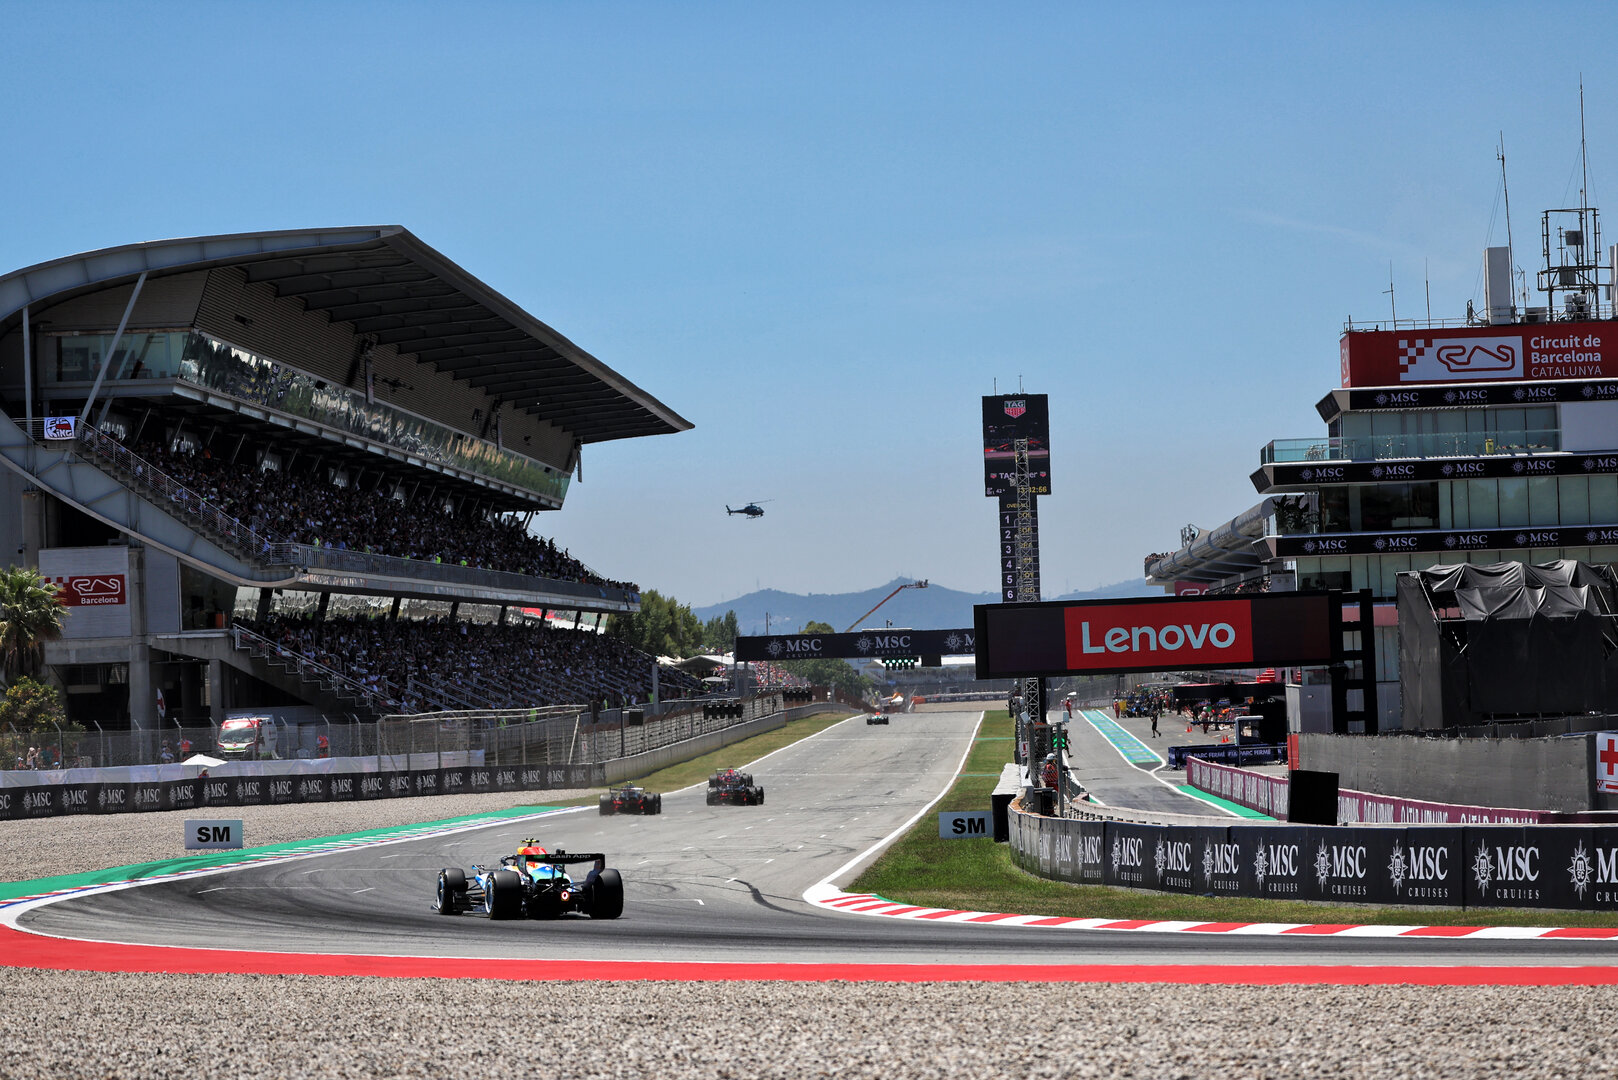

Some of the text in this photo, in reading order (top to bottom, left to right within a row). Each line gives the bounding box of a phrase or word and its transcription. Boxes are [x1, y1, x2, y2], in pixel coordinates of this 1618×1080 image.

[1530, 334, 1601, 349] Circuit de
[1531, 350, 1602, 364] Barcelona
[1531, 366, 1602, 377] CATALUNYA
[1459, 390, 1488, 400] MSC
[1528, 387, 1557, 397] MSC
[1597, 385, 1618, 395] MS
[1391, 392, 1419, 402] MSC
[1386, 465, 1415, 475] MSC
[1456, 463, 1485, 472] MSC
[1527, 460, 1556, 470] MSC
[1315, 468, 1344, 477] MSC
[1005, 515, 1010, 524] 1
[1005, 530, 1011, 539] 2
[1459, 535, 1488, 544] MSC
[1529, 532, 1559, 542] MSC
[1318, 540, 1347, 550] MSC
[1389, 537, 1418, 547] MSC
[1005, 545, 1011, 554] 3
[1006, 560, 1012, 568] 4
[1006, 575, 1013, 583] 5
[80, 596, 119, 604] Barcelona
[1007, 590, 1014, 599] 6
[874, 635, 911, 649] MSC
[1081, 621, 1236, 654] Lenovo
[786, 638, 822, 652] MSC
[177, 785, 194, 800] MSC
[210, 783, 228, 798] MSC
[244, 782, 260, 796] MSC
[276, 780, 292, 795] MSC
[307, 780, 323, 794] MSC
[32, 791, 52, 807] MSC
[69, 789, 88, 805] MSC
[107, 789, 125, 804] MSC
[143, 788, 160, 803] MSC
[0, 795, 11, 810] SC
[952, 817, 987, 835] SM
[196, 826, 231, 843] SM
[1084, 836, 1101, 864] MSC
[1121, 837, 1143, 867] MSC
[1167, 841, 1192, 873] MSC
[1214, 844, 1240, 874] MSC
[1269, 845, 1299, 877] MSC
[1331, 846, 1367, 878] MSC
[1408, 847, 1448, 880] MSC
[1496, 846, 1540, 881] MSC
[1166, 876, 1192, 888] CRUISES
[1213, 880, 1240, 891] CRUISES
[1268, 882, 1299, 893] CRUISES
[1331, 884, 1367, 896] CRUISES
[1408, 887, 1449, 898] CRUISES
